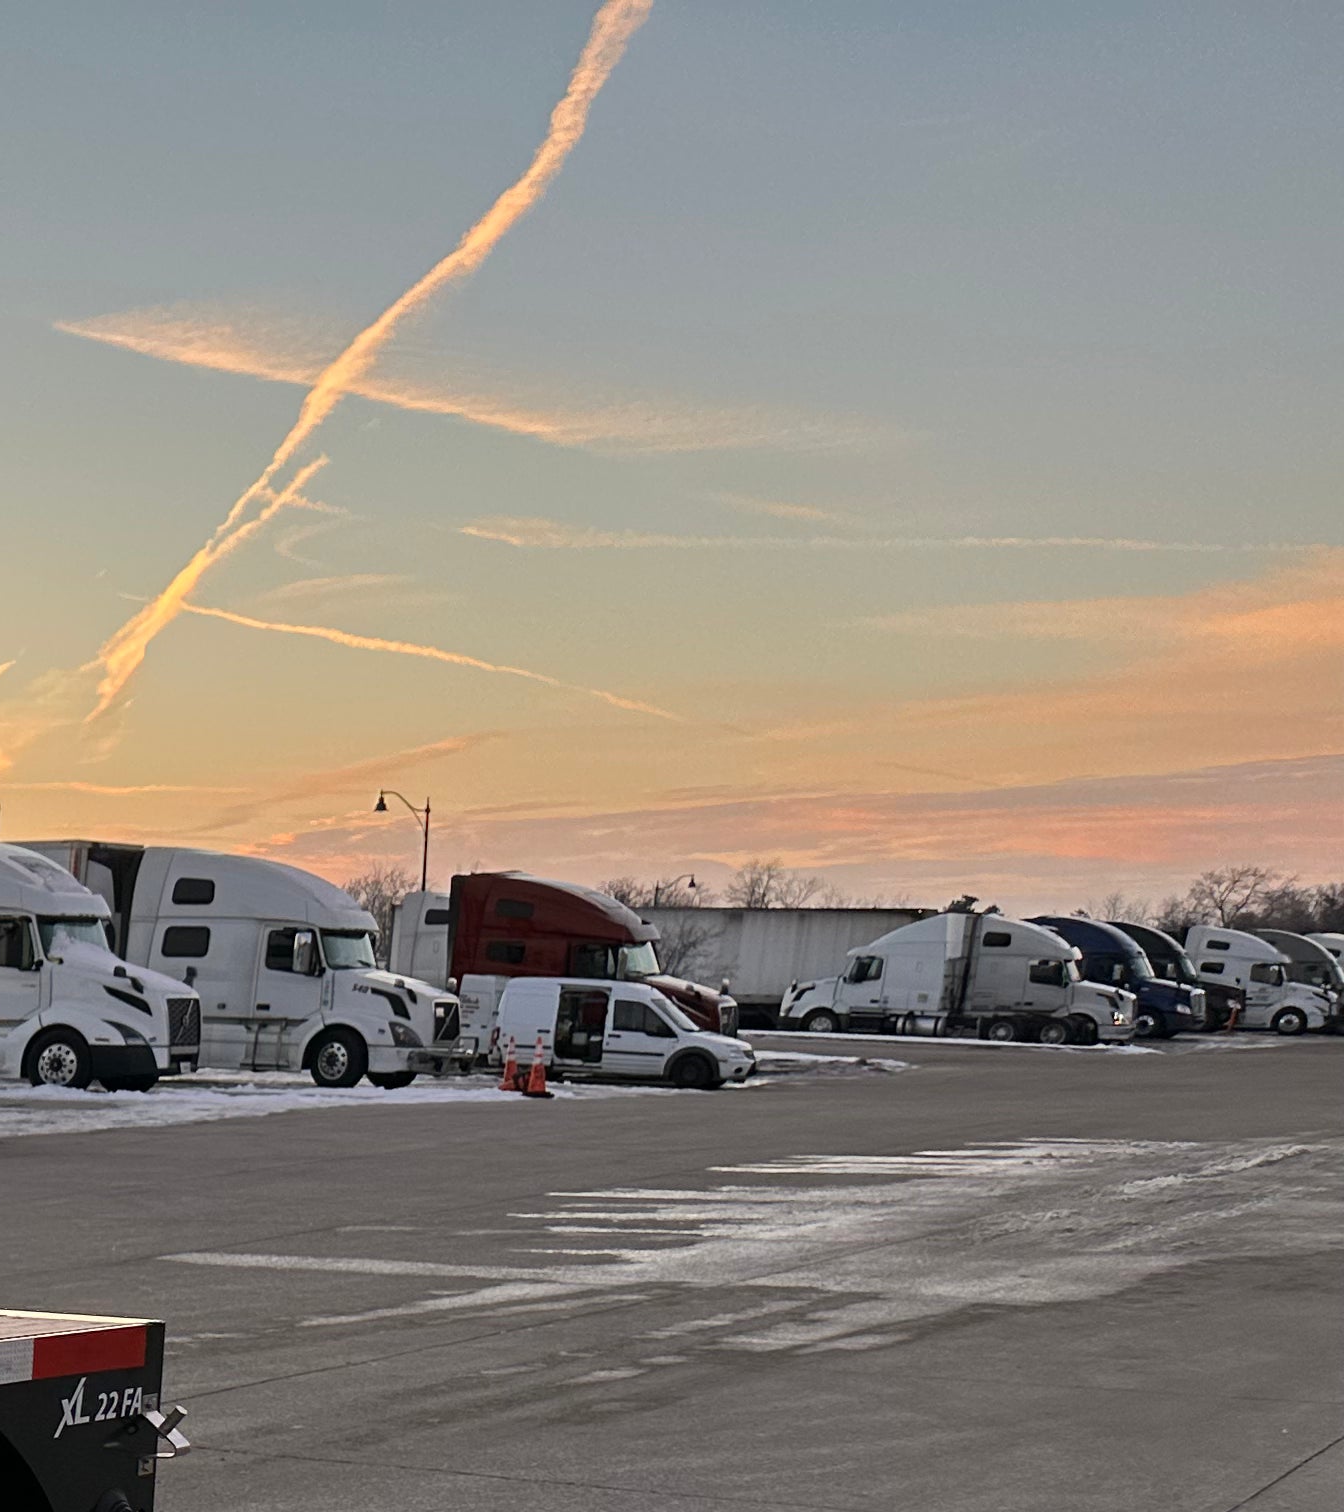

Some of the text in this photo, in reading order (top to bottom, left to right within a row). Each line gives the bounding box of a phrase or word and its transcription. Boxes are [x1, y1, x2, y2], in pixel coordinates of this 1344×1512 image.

[54, 1377, 143, 1438] XL 22 FA
